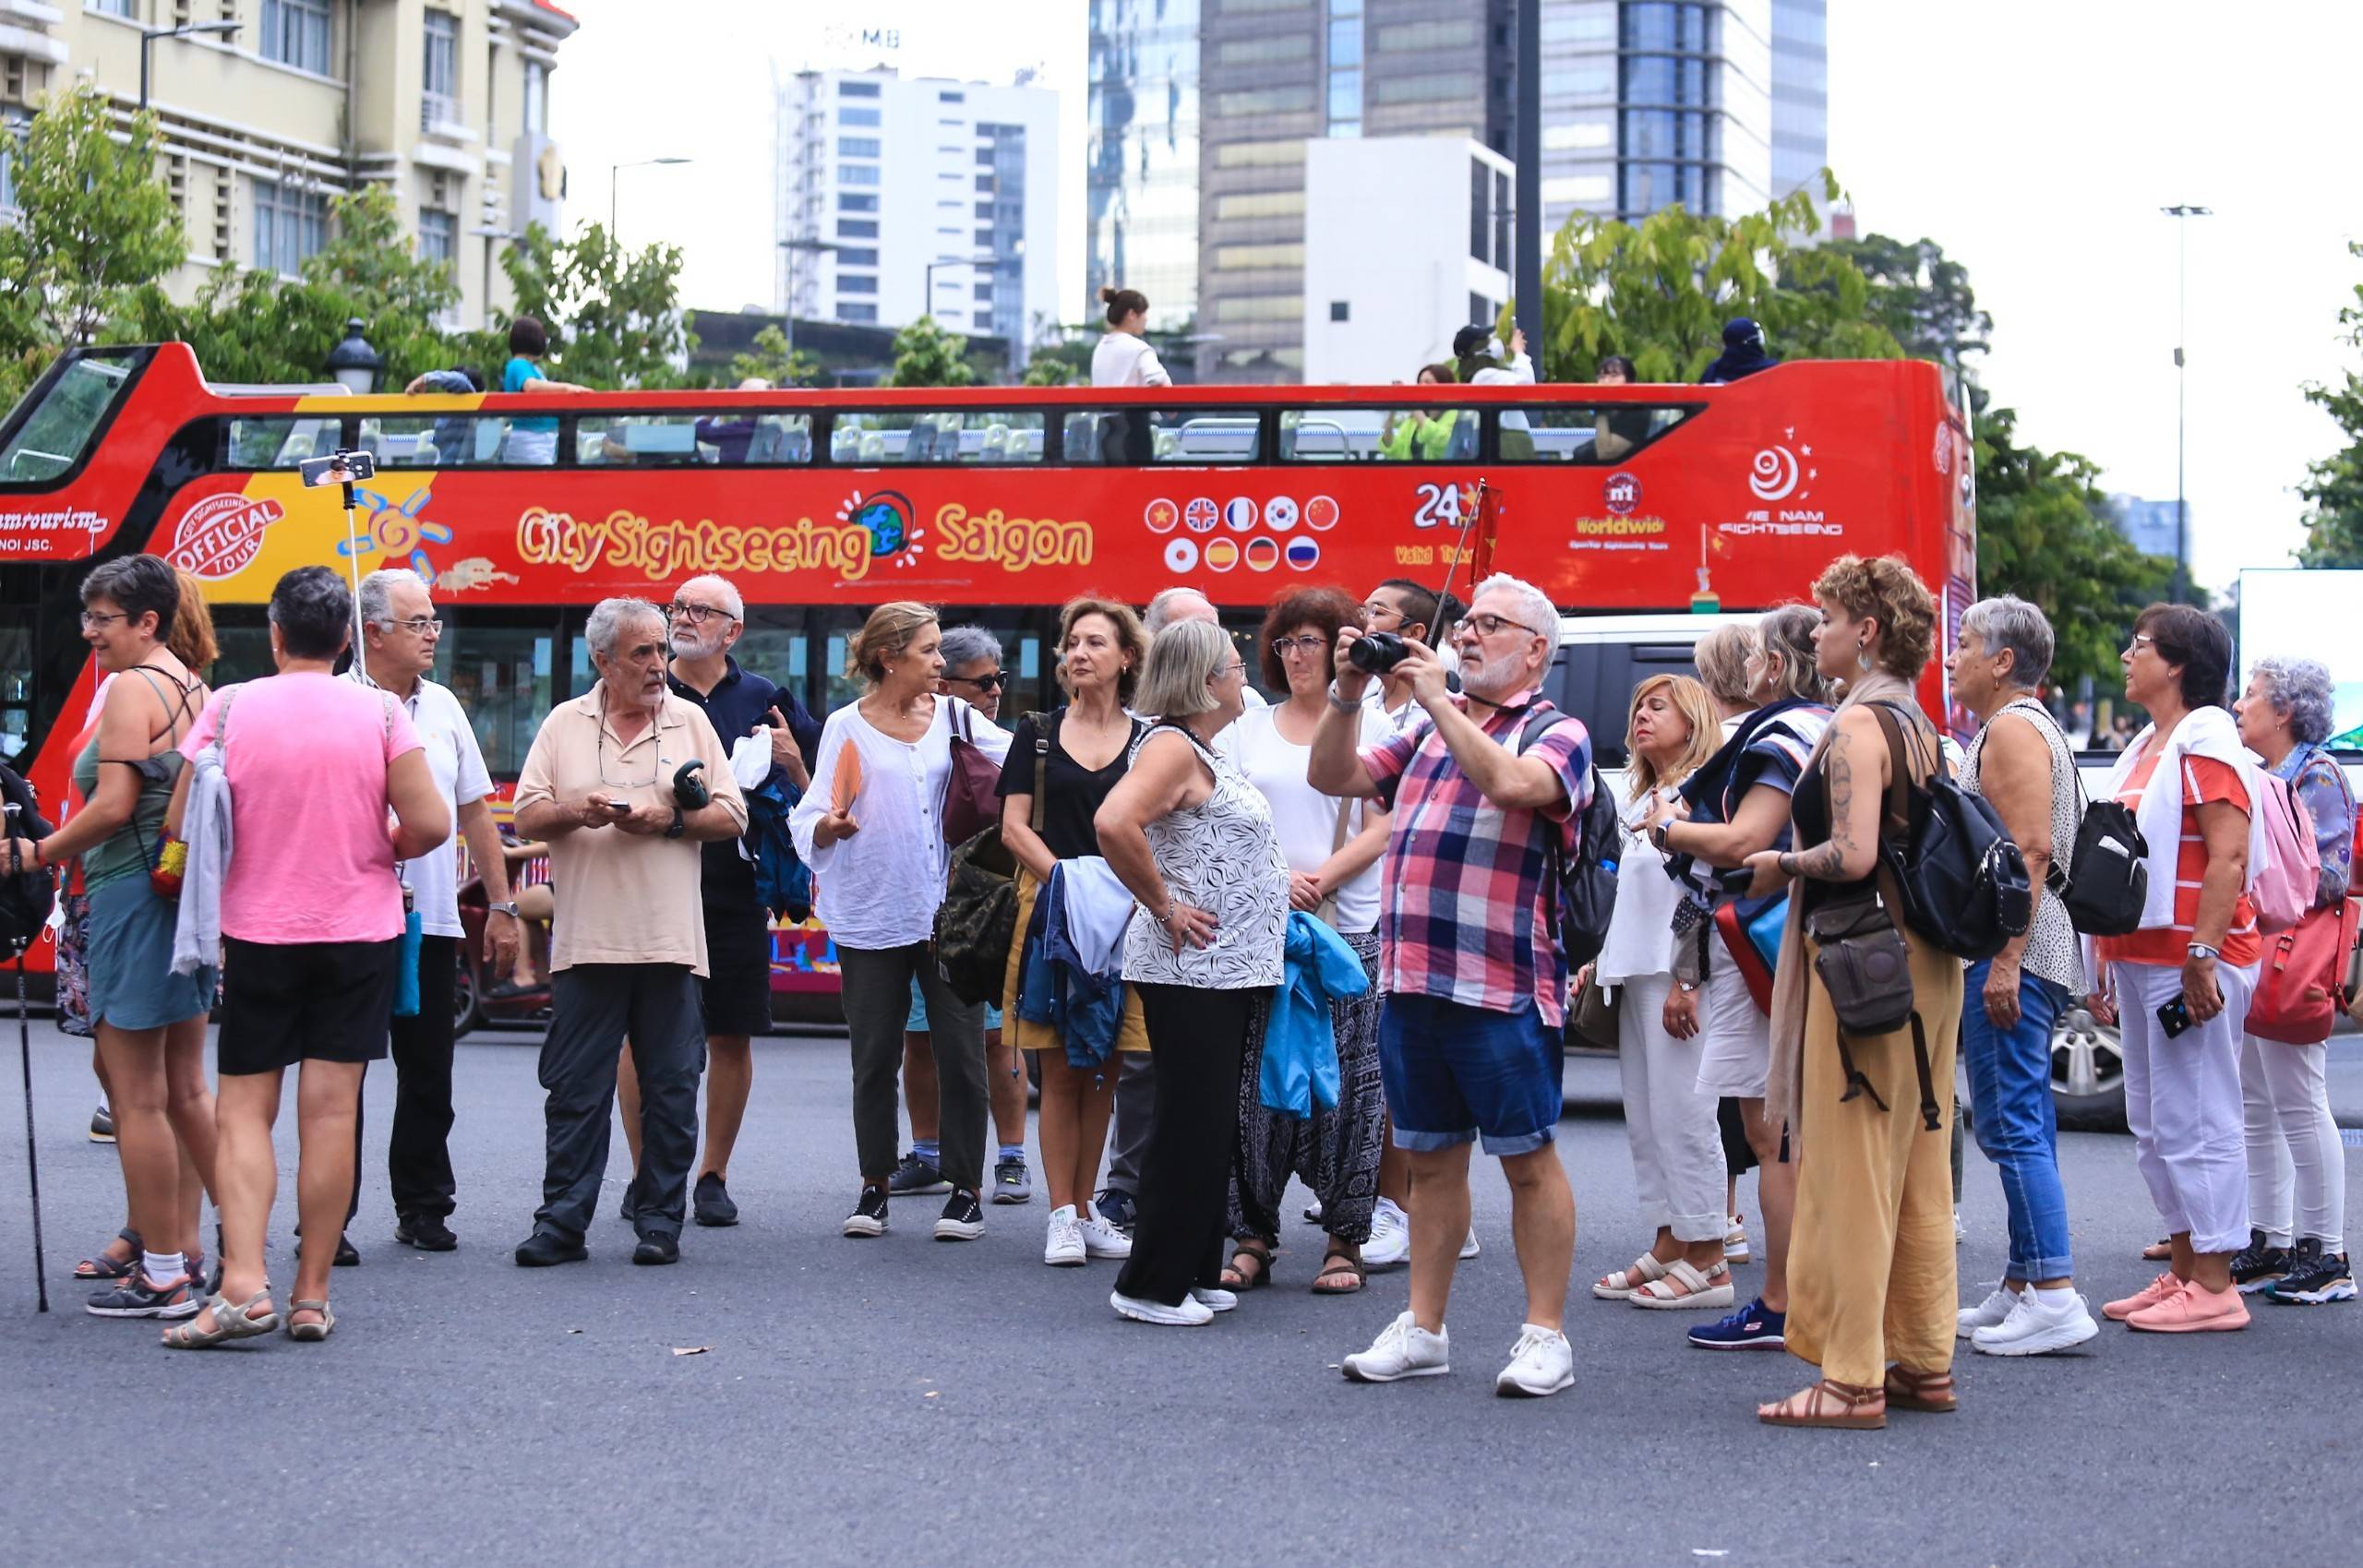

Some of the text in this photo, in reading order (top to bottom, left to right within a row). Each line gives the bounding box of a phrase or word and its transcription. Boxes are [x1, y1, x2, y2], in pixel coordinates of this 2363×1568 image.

[0, 506, 108, 533] mtourism
[1780, 510, 1824, 521] NAM
[176, 503, 278, 571] OFFICIAL
[936, 503, 1093, 572] Saigon
[214, 538, 259, 573] TOUR
